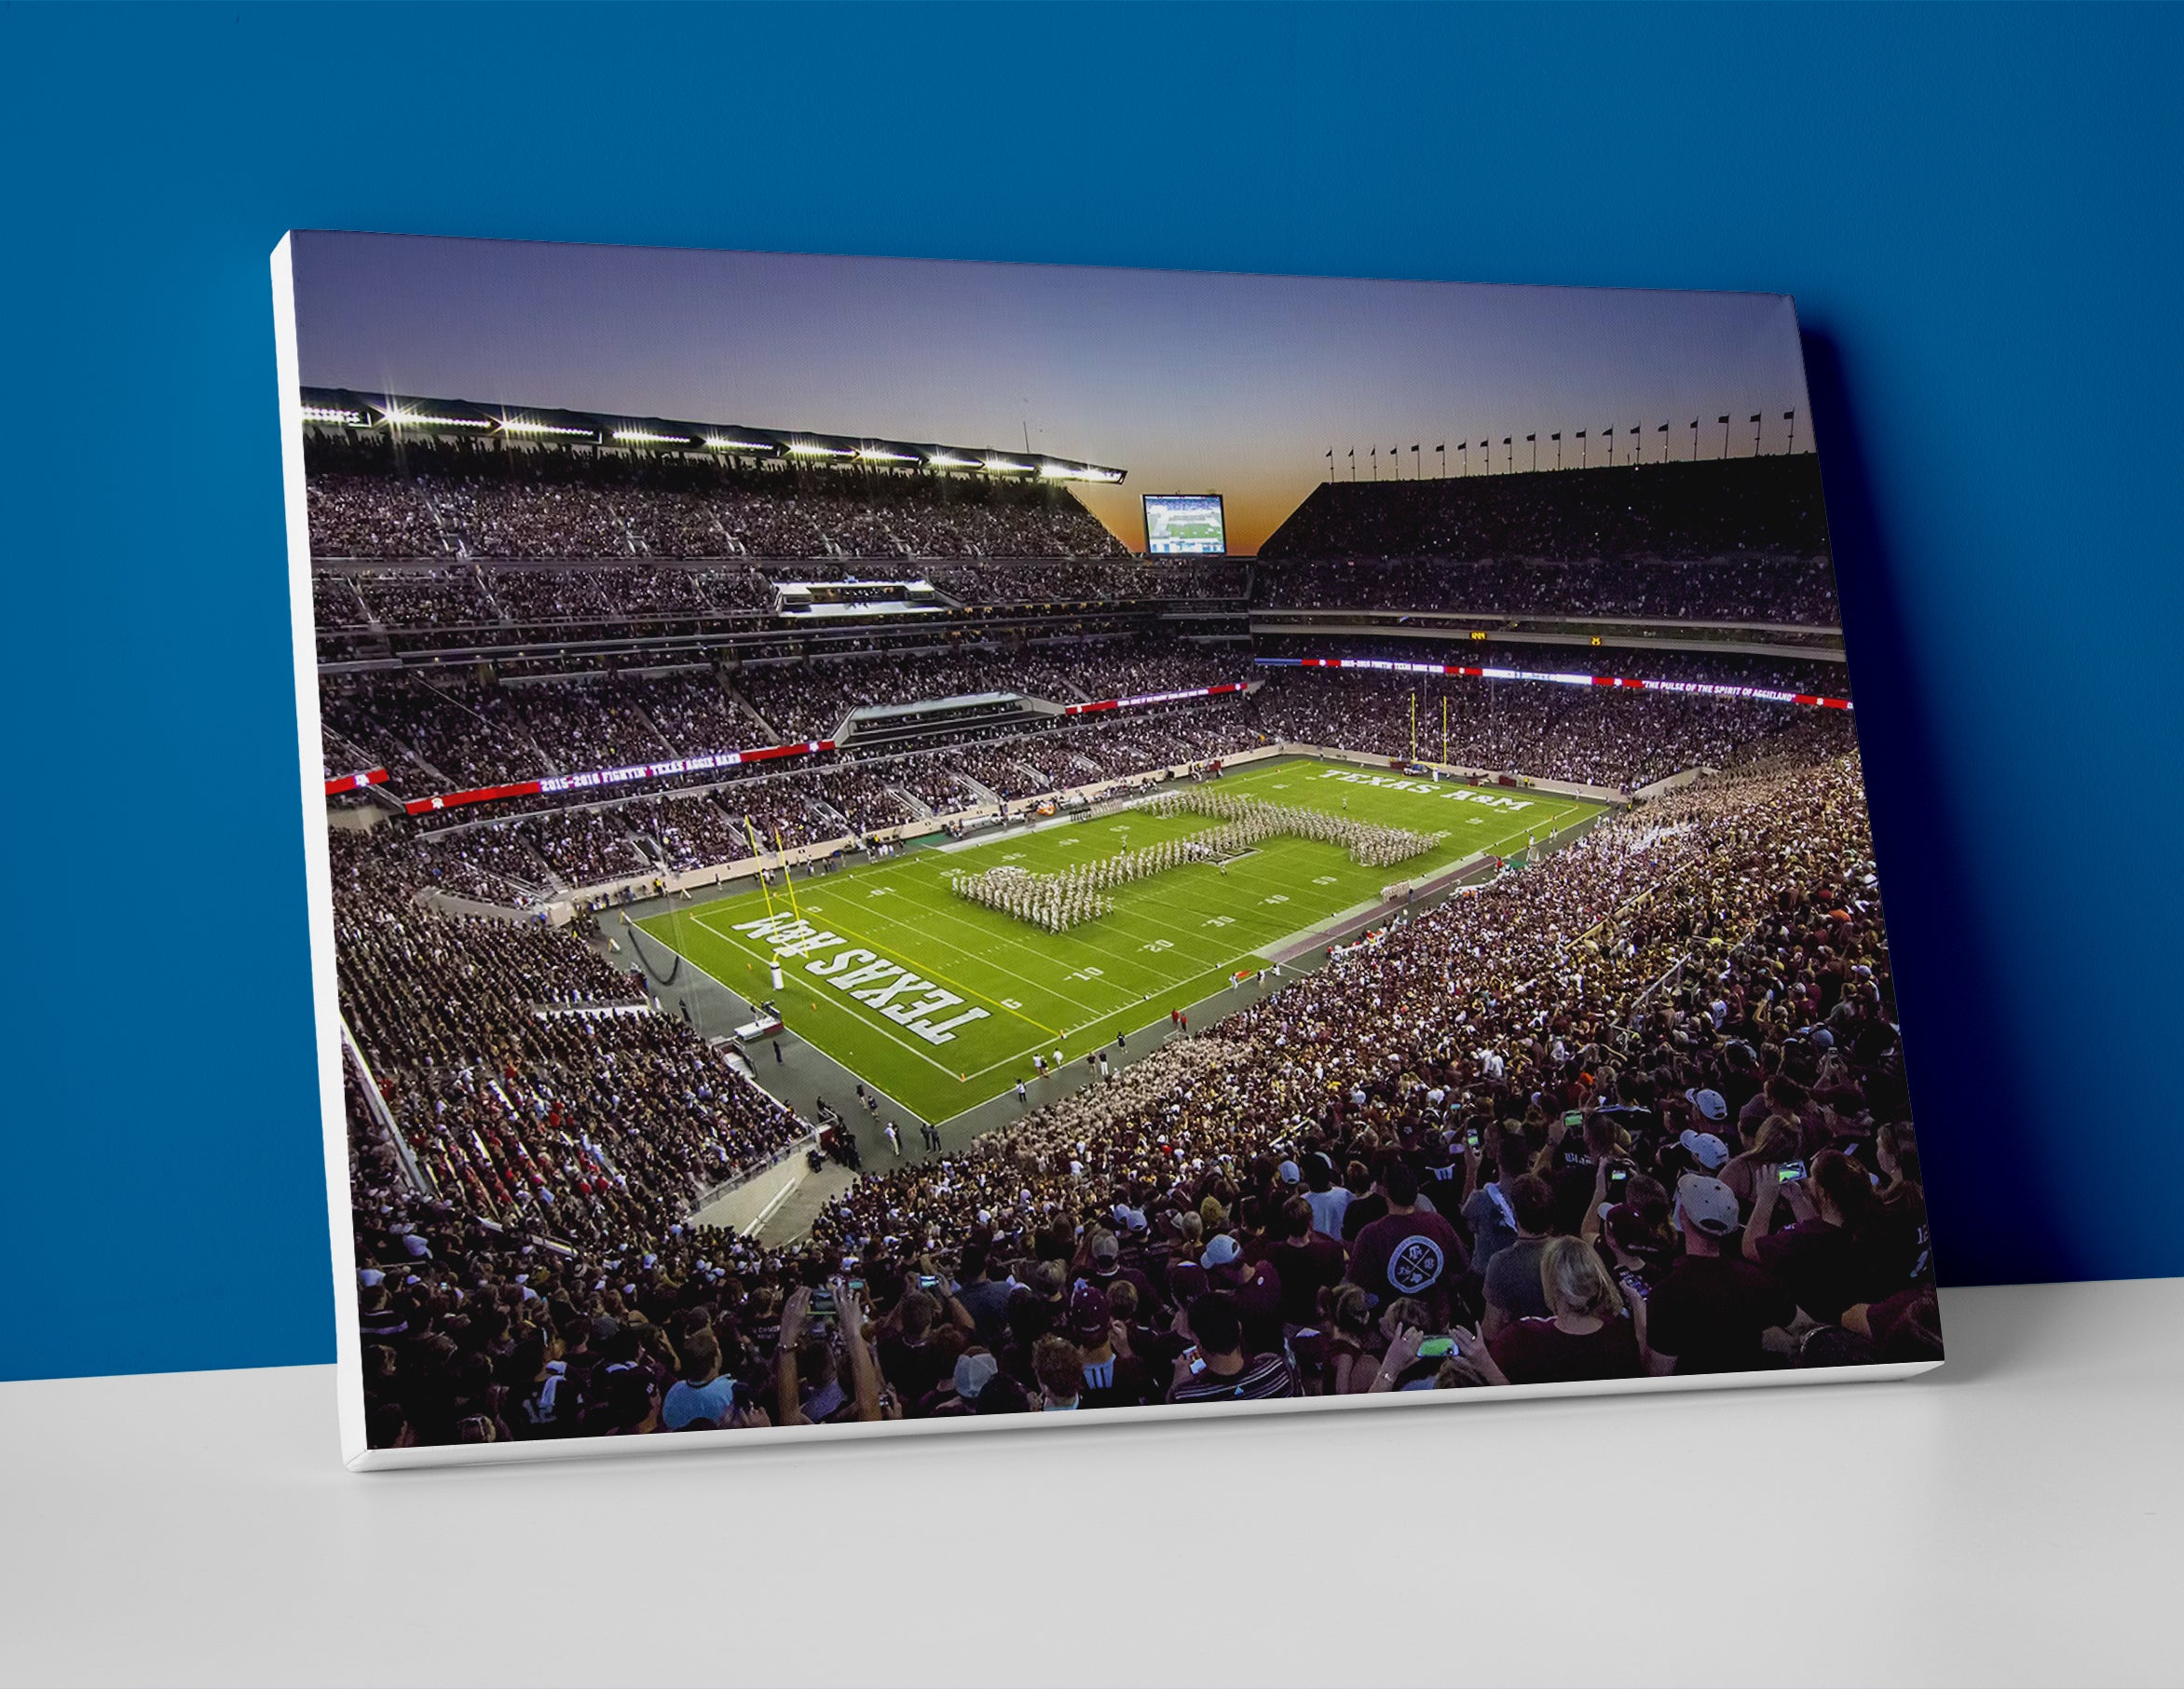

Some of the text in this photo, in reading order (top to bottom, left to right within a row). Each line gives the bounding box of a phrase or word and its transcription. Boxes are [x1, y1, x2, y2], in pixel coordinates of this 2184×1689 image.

[1659, 681, 1686, 691] PULSE
[1685, 683, 1698, 691] OF
[1698, 684, 1714, 693] THE
[1714, 686, 1742, 695] SPIRIT
[1741, 688, 1754, 696] OF
[650, 759, 684, 775] TEXAS
[1319, 770, 1536, 810] TEXAS A&M
[730, 911, 992, 1046] TEXAS A&M
[1072, 966, 1104, 982] 10
